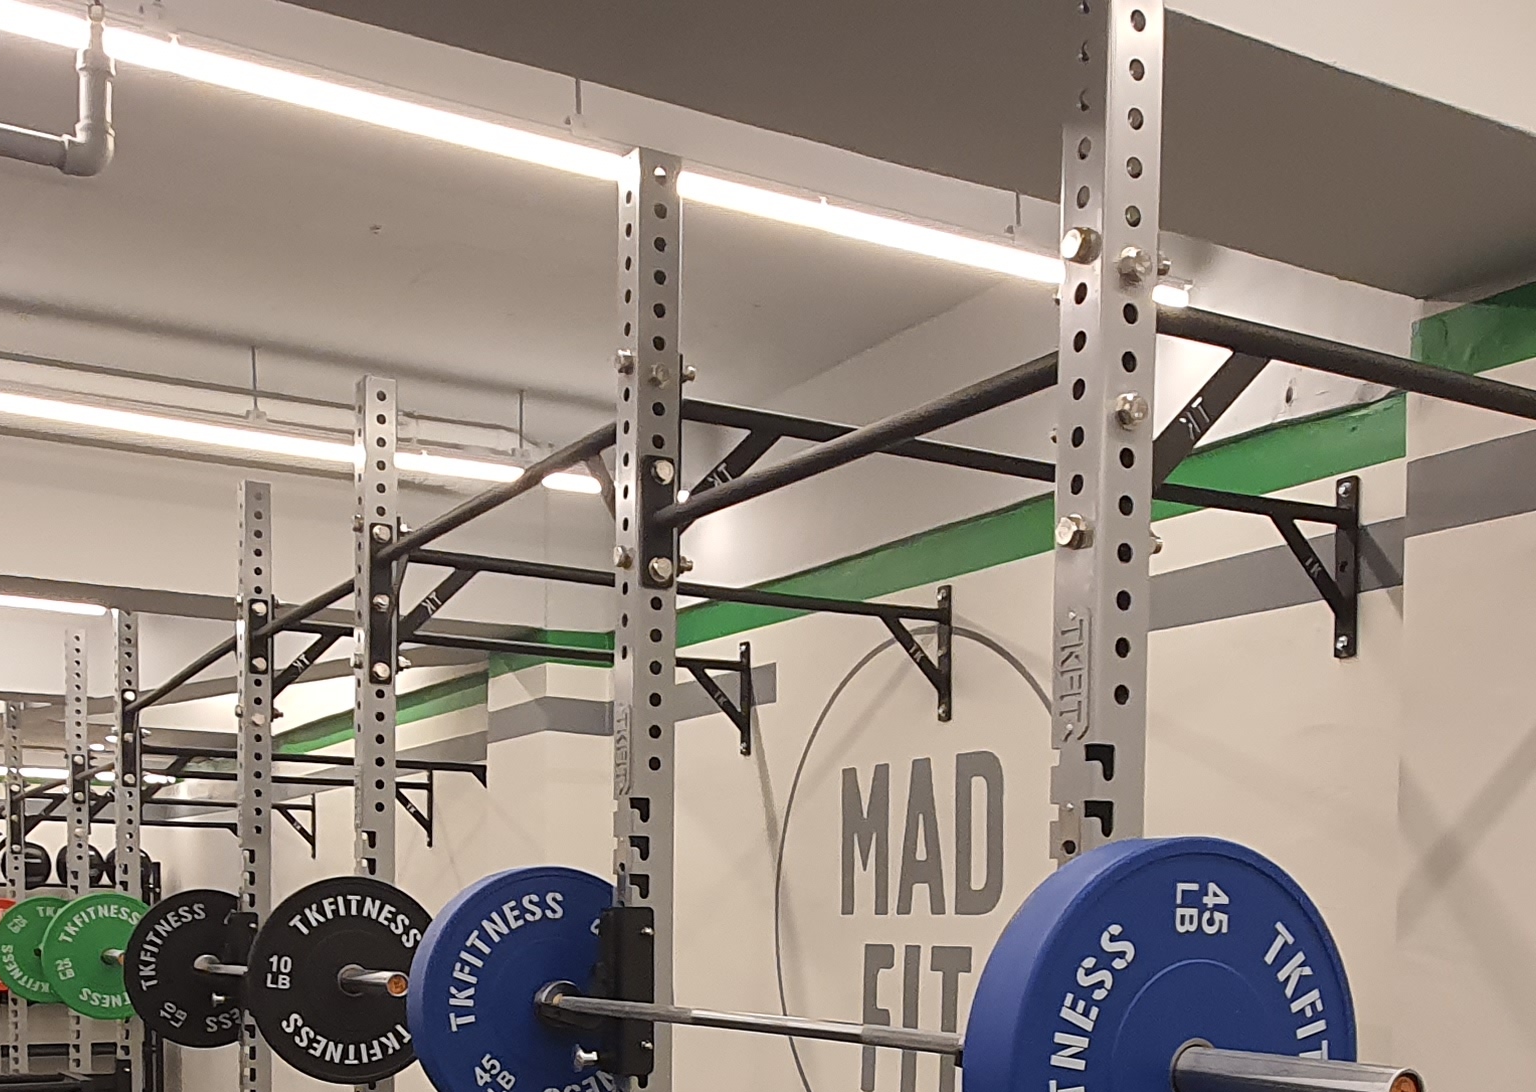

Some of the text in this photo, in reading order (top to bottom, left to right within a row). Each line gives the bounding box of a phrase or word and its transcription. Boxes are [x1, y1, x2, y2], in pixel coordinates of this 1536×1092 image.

[841, 751, 1003, 915] MAD
[58, 904, 143, 943] TKFITNESS
[288, 895, 423, 949] TKFITNESS
[1174, 881, 1199, 935] LB
[1200, 881, 1230, 935] 45
[1, 945, 52, 993] KFITNESS
[139, 903, 208, 992] TKFITNESS
[268, 954, 293, 974] 10
[449, 891, 565, 1033] TKFITNESS
[266, 972, 292, 990] LB
[159, 1002, 177, 1021] 10
[169, 1008, 188, 1029] LB
[280, 1012, 413, 1065] TKFITNESS
[473, 1053, 502, 1088] 45
